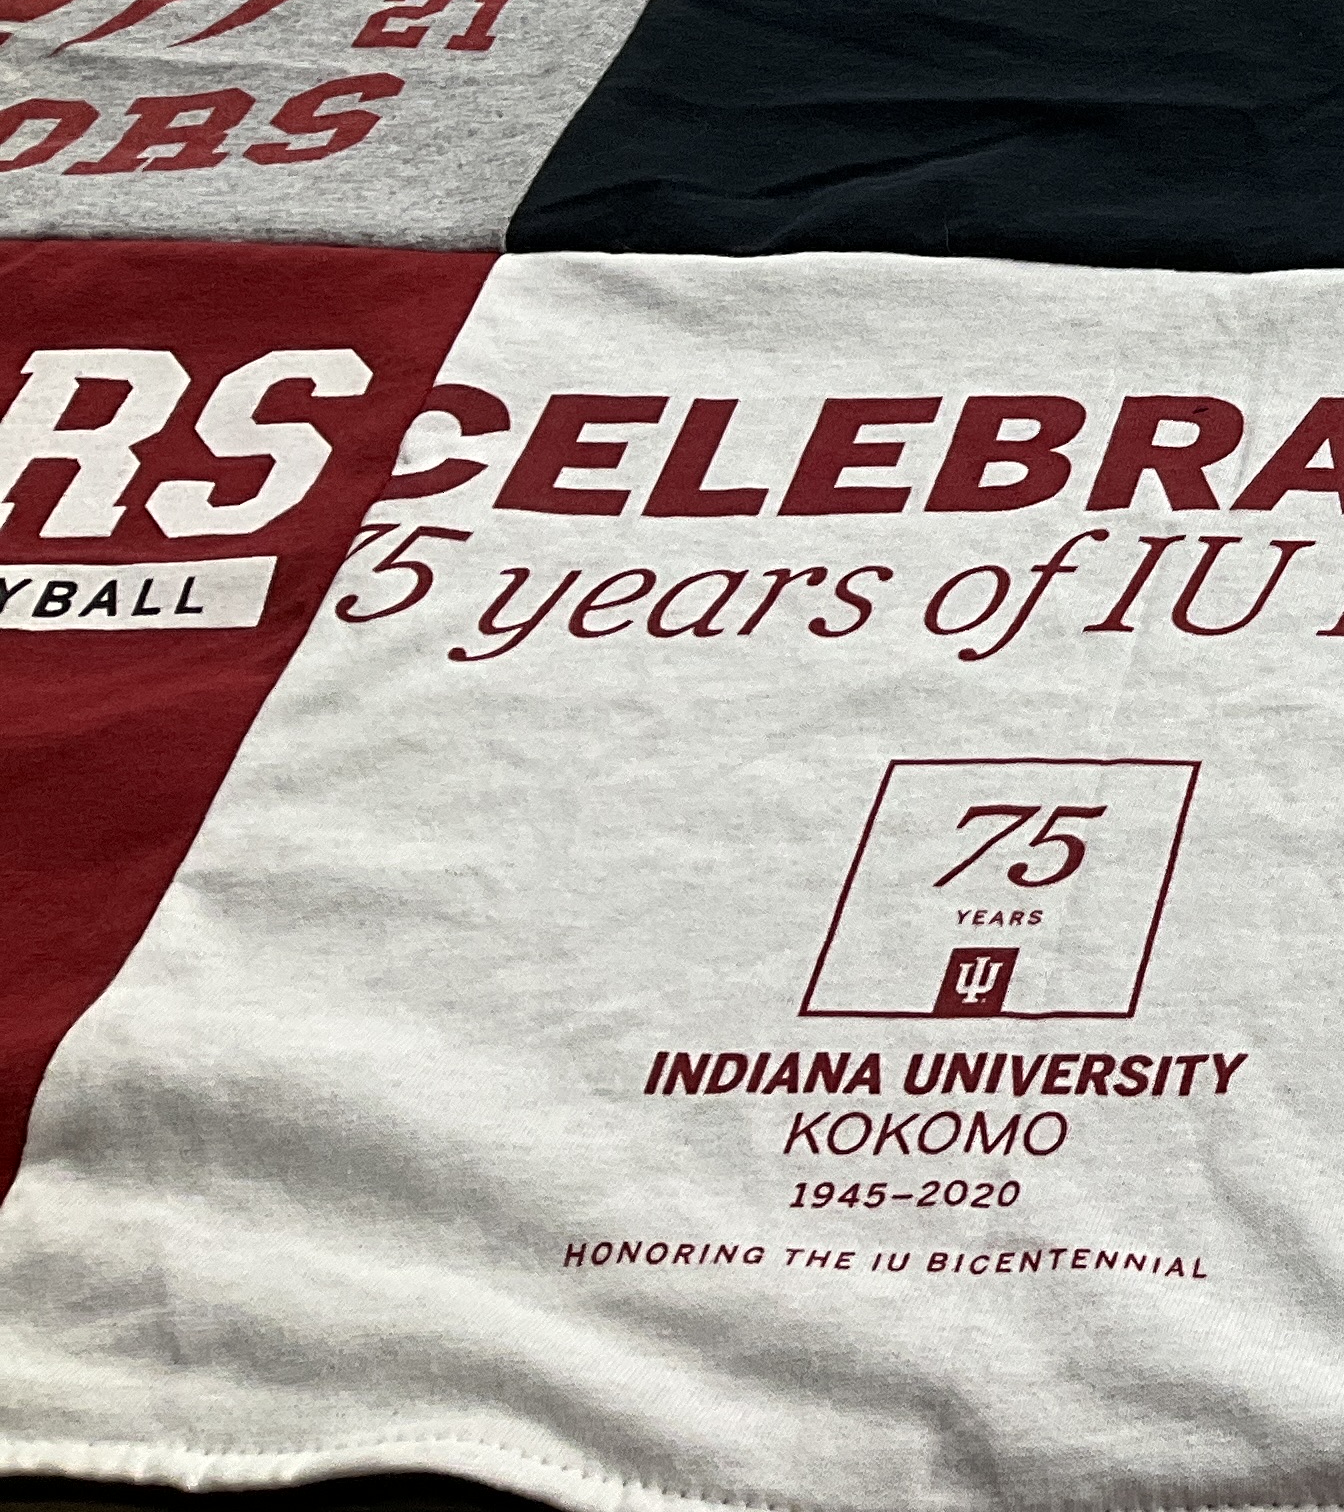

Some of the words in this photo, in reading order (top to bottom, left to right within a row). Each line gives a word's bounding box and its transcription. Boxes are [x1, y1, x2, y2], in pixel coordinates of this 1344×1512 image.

[448, 557, 894, 663] years
[924, 528, 1110, 662] of
[1083, 533, 1315, 637] IU
[933, 804, 1108, 888] 75
[955, 908, 1044, 927] YEARS
[643, 1051, 882, 1096] INDIANA
[902, 1051, 1249, 1097] UNIVERSITY
[783, 1110, 1070, 1157] KOKOMO
[563, 1239, 765, 1270] HONORING
[785, 1248, 856, 1272] THE
[871, 1252, 910, 1273] IU
[926, 1246, 1209, 1280] BICENTENNIAL
